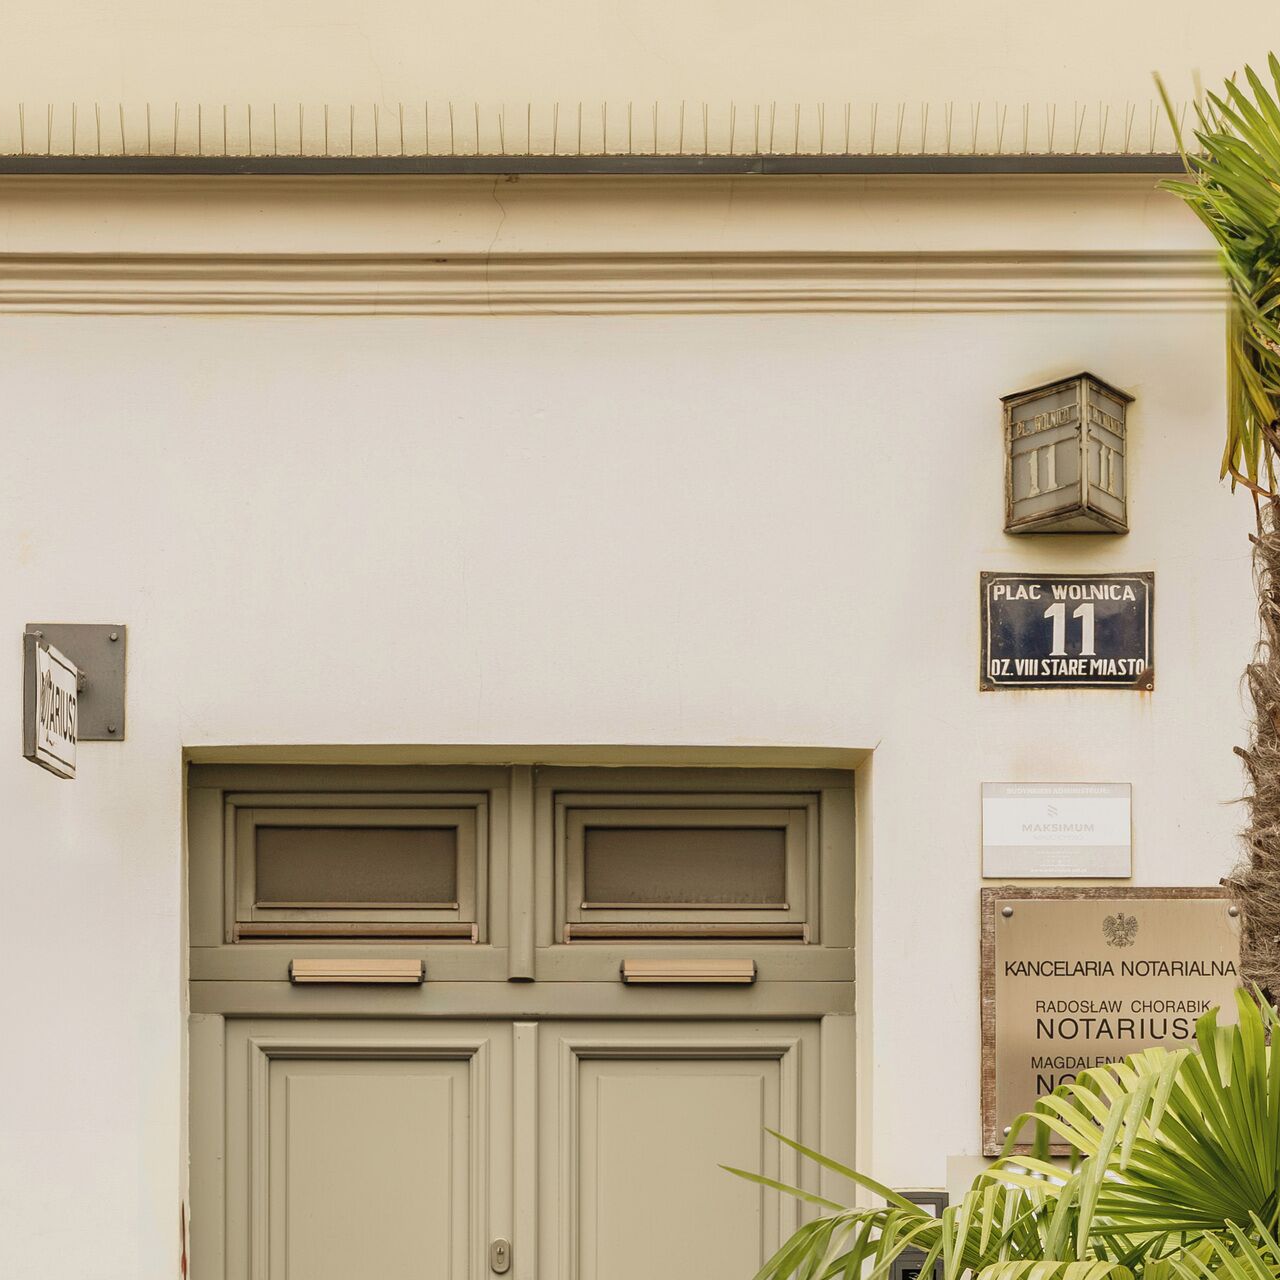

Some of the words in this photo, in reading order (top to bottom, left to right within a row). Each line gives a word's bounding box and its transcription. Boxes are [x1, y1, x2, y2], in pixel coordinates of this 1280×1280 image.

[1028, 444, 1060, 498] 11
[1099, 443, 1114, 494] 11
[993, 584, 1041, 601] PLAC
[1051, 584, 1136, 601] WOLNICA
[1043, 602, 1097, 656] 11
[991, 659, 1014, 676] DZ.
[1014, 659, 1039, 676] VIII
[1040, 659, 1087, 676] STARE
[1089, 658, 1145, 676] MIASTO
[1021, 823, 1095, 833] MAKSIMUM
[1005, 960, 1115, 977] KANCELARIA
[1121, 960, 1237, 977] NOTARIALNA
[1035, 1000, 1123, 1014] RADOSŁAW
[1130, 1000, 1211, 1014] CHORABIK
